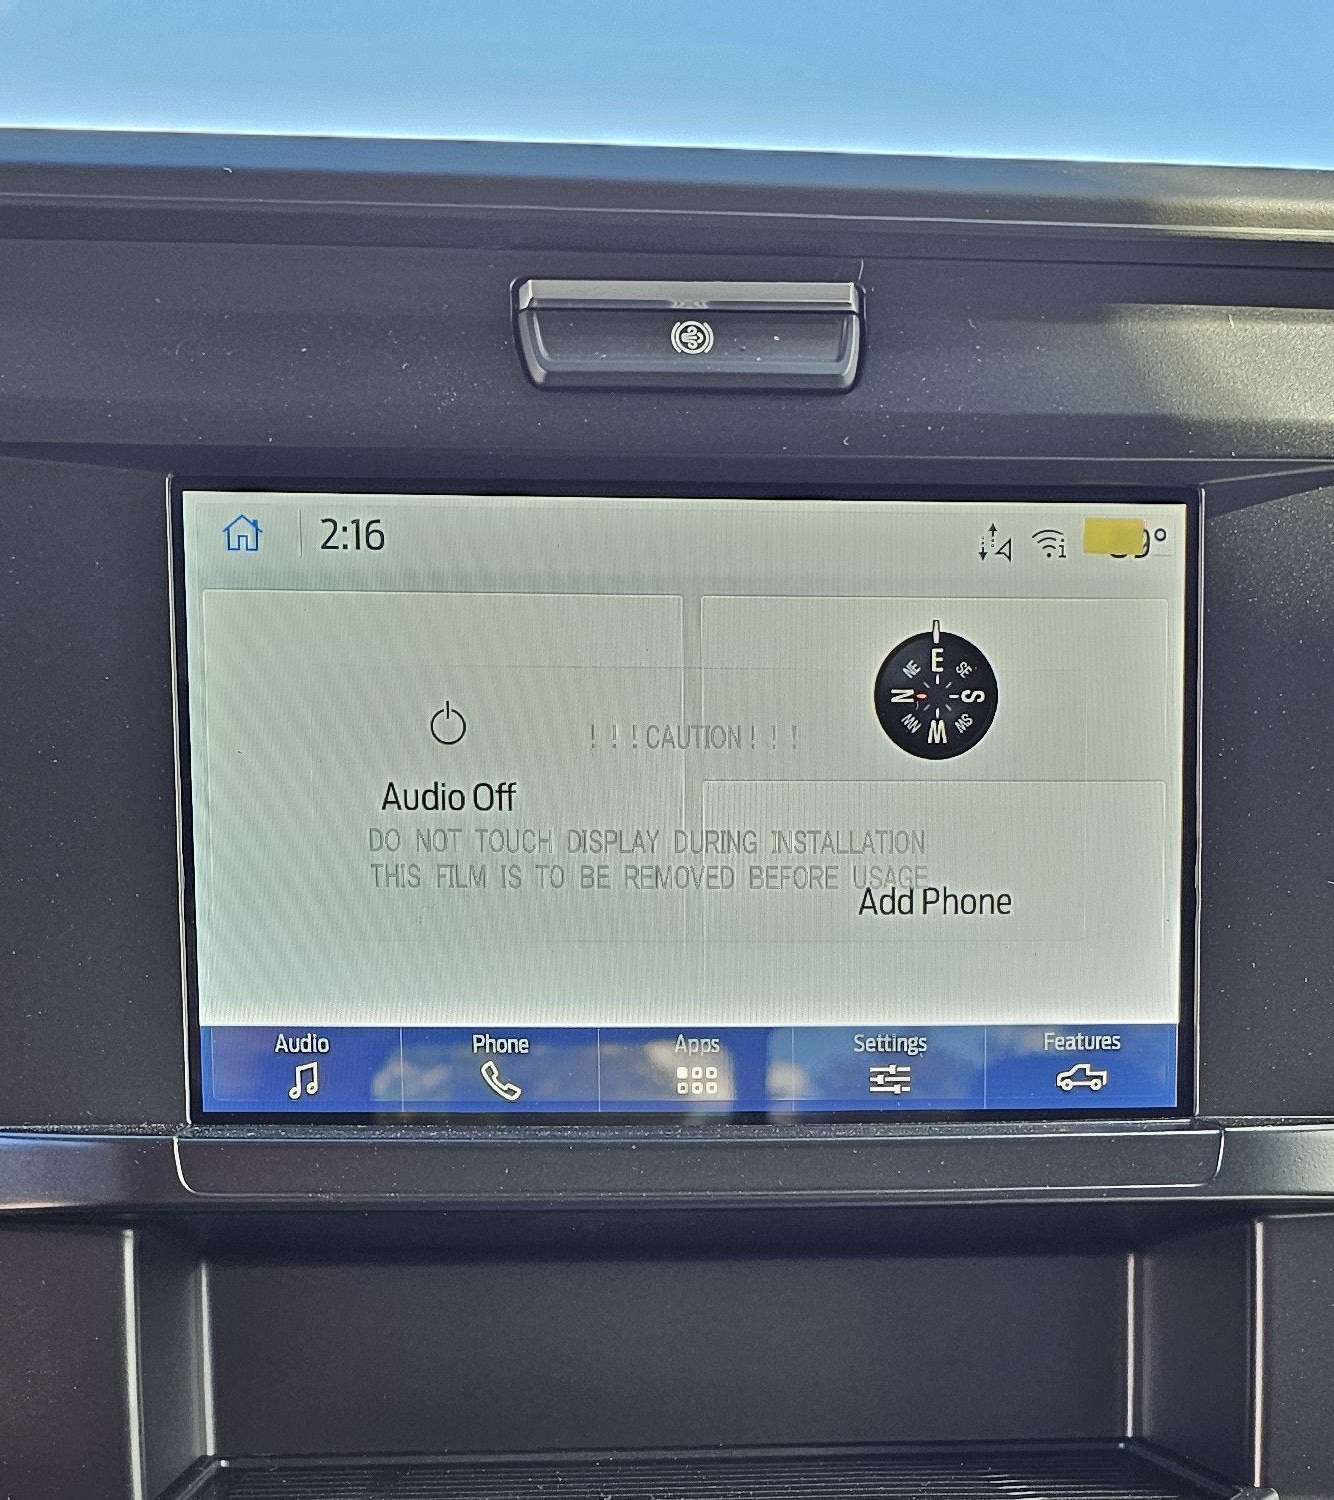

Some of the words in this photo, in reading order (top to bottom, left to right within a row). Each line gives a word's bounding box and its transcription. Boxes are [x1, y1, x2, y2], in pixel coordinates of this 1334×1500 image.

[319, 518, 386, 552] 2:16
[901, 659, 922, 680] NE
[930, 647, 945, 673] E
[955, 661, 973, 679] SE
[960, 689, 986, 703] S
[382, 781, 466, 811] Audio
[472, 781, 517, 811] Off
[368, 827, 401, 853] DO
[417, 828, 463, 853] NOT
[475, 828, 553, 854] TOUCH
[568, 829, 659, 854] DISPLAY
[674, 829, 757, 855] DURING
[772, 829, 926, 855] INSTALLATION
[370, 863, 421, 889] THIS
[437, 864, 486, 889] FILM
[501, 864, 522, 889] IS
[535, 864, 565, 889] TO
[581, 865, 611, 889] BE
[625, 865, 735, 890] REMOVED
[749, 865, 839, 890] BEFORE
[853, 865, 928, 890] USAGE
[858, 886, 914, 915] Add
[923, 886, 1012, 915] Phone
[274, 1033, 330, 1054] Audio
[472, 1033, 530, 1054] Phone
[674, 1033, 721, 1057] Apps
[853, 1033, 928, 1056] Settings
[1043, 1031, 1122, 1052] Features
